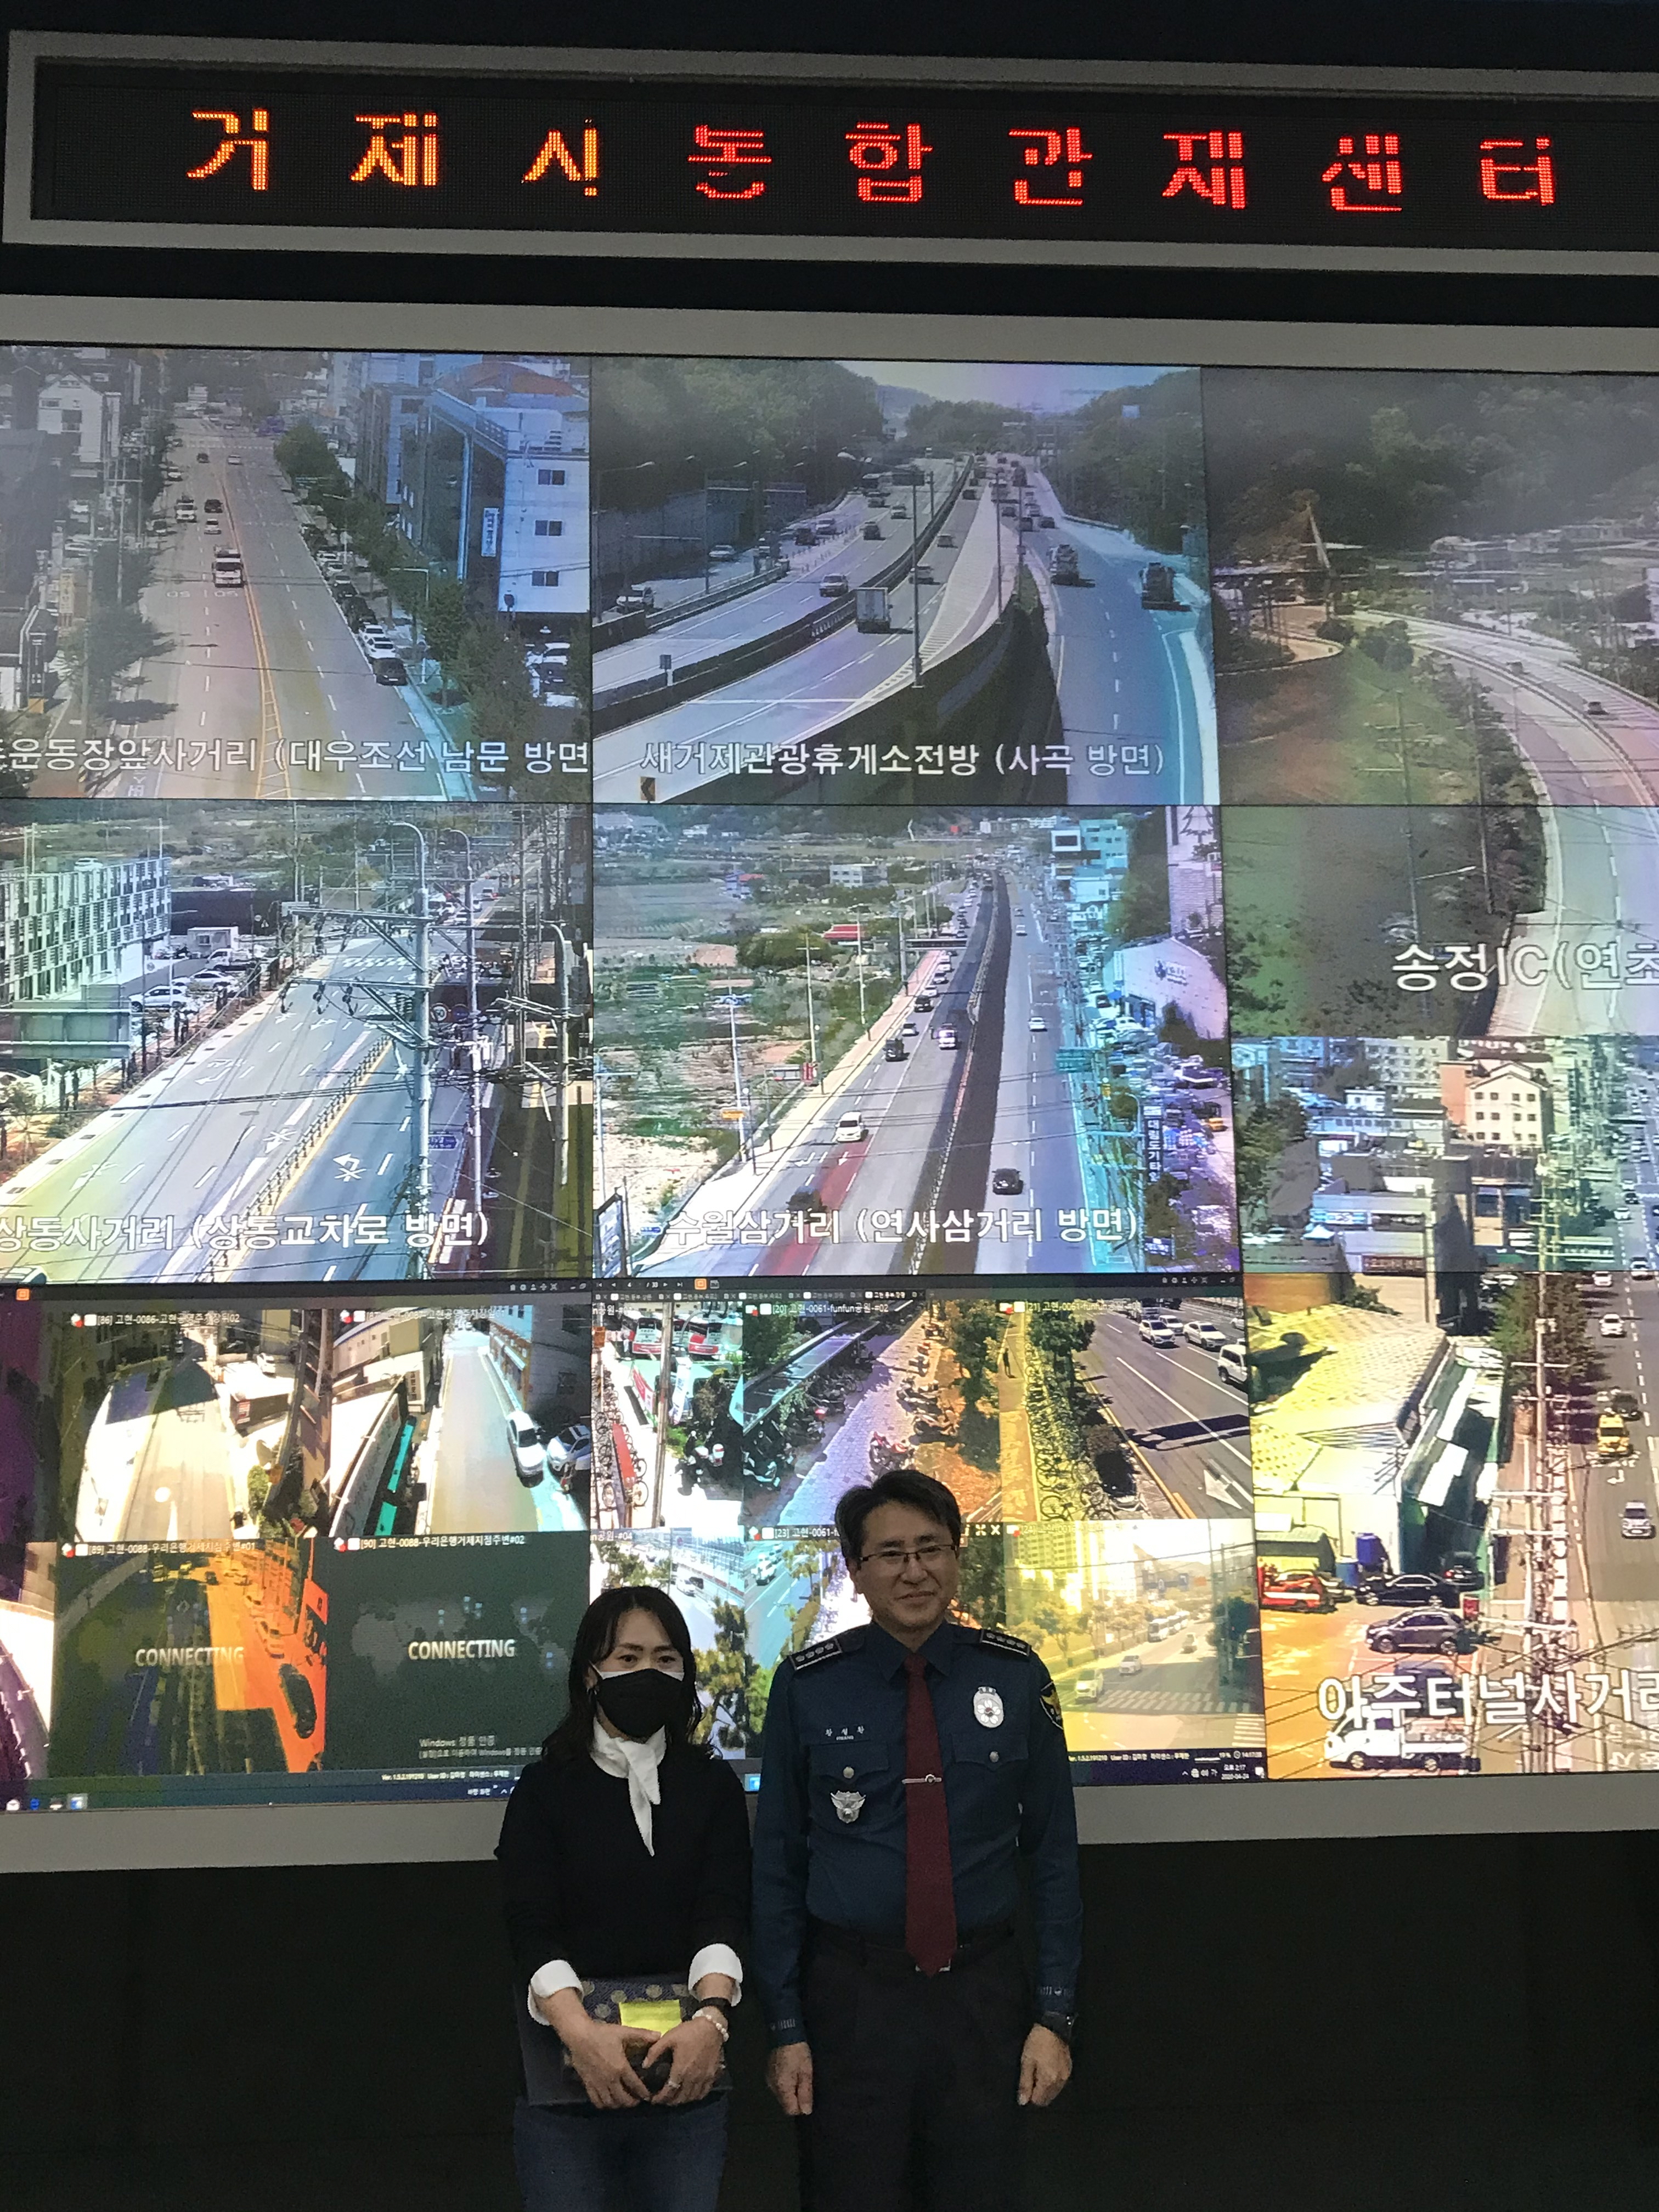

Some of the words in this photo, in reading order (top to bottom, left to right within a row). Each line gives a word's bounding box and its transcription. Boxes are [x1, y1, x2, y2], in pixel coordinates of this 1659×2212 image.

[0, 738, 257, 771] 운동장앞사거리
[274, 738, 426, 772] (대우조선
[441, 741, 509, 773] 남문
[524, 741, 589, 774] 방면
[640, 741, 979, 776] 새거제관광휴게소전방
[995, 743, 1074, 776] (사곡
[1088, 743, 1164, 776] 방면)
[191, 1213, 389, 1251] (상동교차로
[405, 1212, 489, 1249] 방면)
[666, 1210, 839, 1244] 수월삼거리
[855, 1209, 1042, 1243] (연사삼거리
[1057, 1208, 1137, 1242] 방면)
[360, 1539, 376, 1550] [90]
[135, 1647, 244, 1667] CONNECTING
[408, 1639, 516, 1660] CONNECTING
[419, 1737, 456, 1747] Windows
